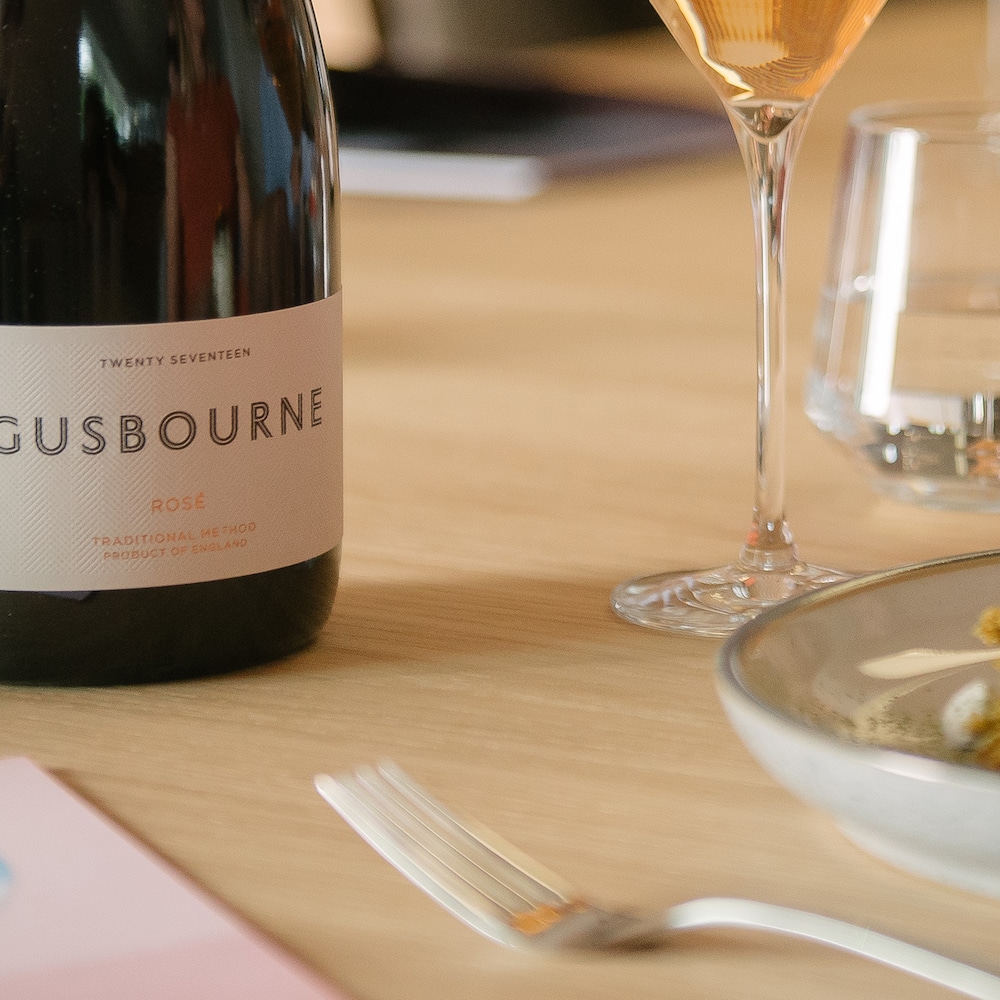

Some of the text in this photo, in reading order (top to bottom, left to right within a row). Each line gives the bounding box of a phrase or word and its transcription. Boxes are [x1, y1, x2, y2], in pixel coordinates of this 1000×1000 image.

[100, 347, 251, 369] TWENTY SEVENTEEN
[0, 387, 322, 456] GUSBOURNE
[151, 492, 206, 513] ROSÉ
[92, 522, 257, 546] TRADITIONAL METHOD
[103, 538, 248, 560] PRODUCT OF ENGLAND
